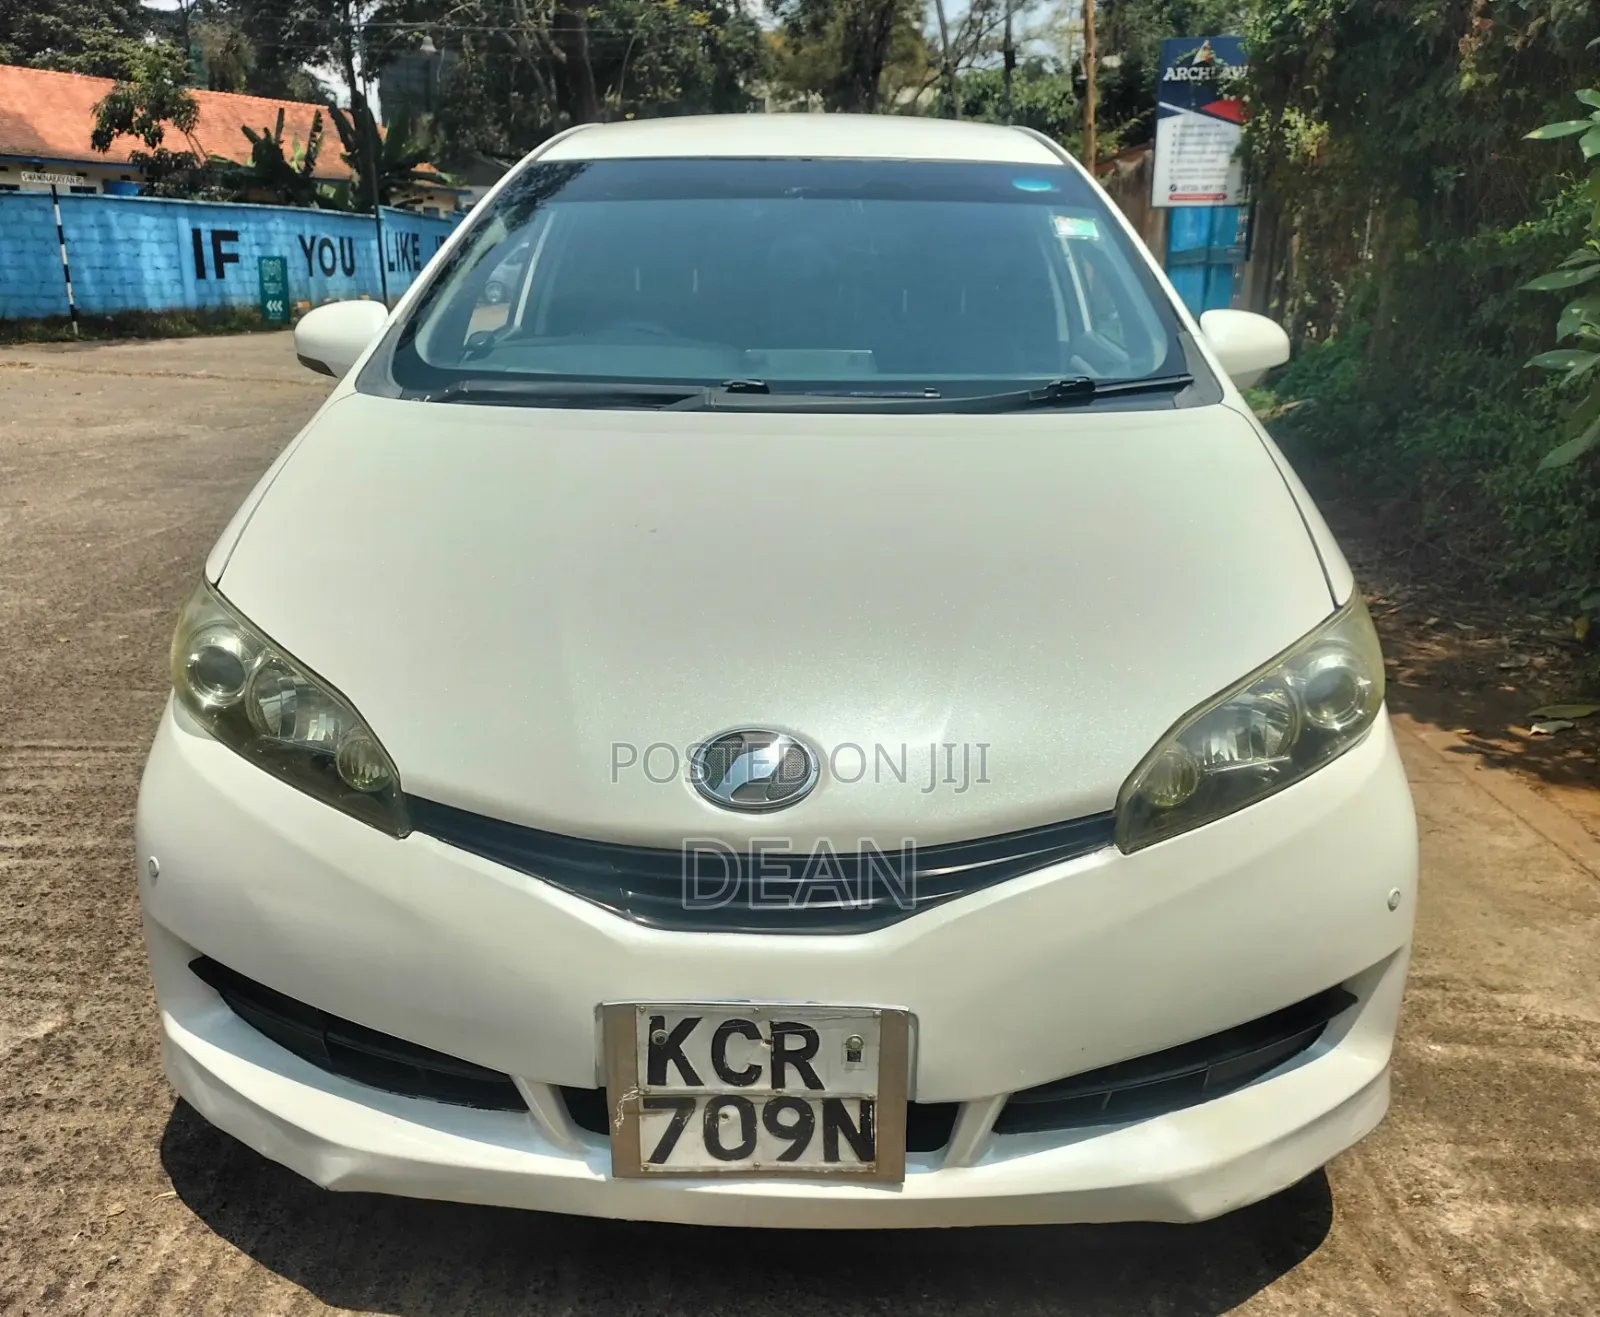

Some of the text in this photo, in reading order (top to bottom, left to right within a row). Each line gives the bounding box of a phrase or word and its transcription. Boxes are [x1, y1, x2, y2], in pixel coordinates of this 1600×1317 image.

[192, 228, 421, 279] IF YOU LIKE
[648, 1015, 825, 1090] KCR
[643, 1095, 876, 1163] 709N
